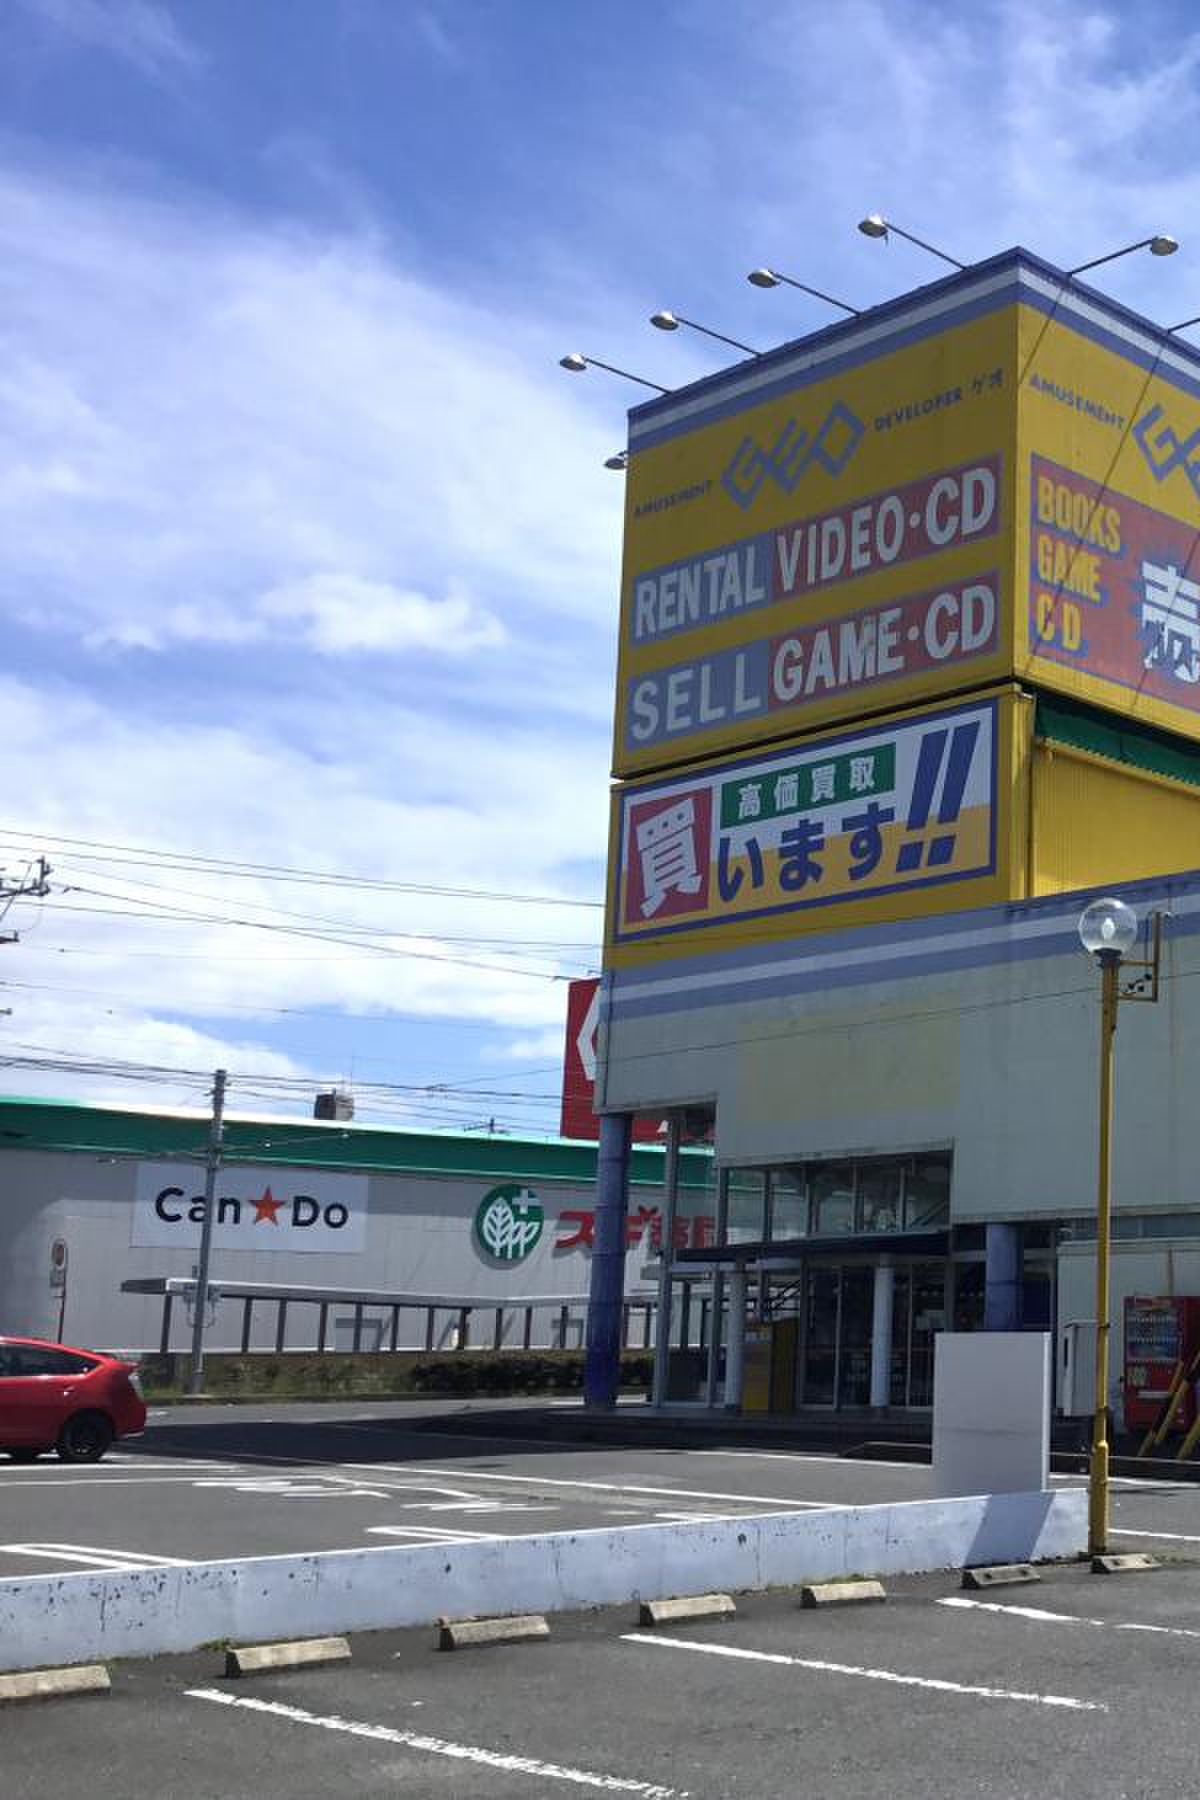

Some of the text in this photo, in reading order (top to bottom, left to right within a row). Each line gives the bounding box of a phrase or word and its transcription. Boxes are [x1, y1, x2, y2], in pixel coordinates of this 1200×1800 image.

[874, 387, 963, 432] DEVELOPER
[1029, 373, 1126, 430] AMUSEMENT
[1036, 475, 1122, 555] BOOKS
[635, 545, 766, 639] RENTAL
[1036, 534, 1102, 602] GAME
[631, 652, 763, 741] SELL
[737, 755, 876, 820] 高価買取
